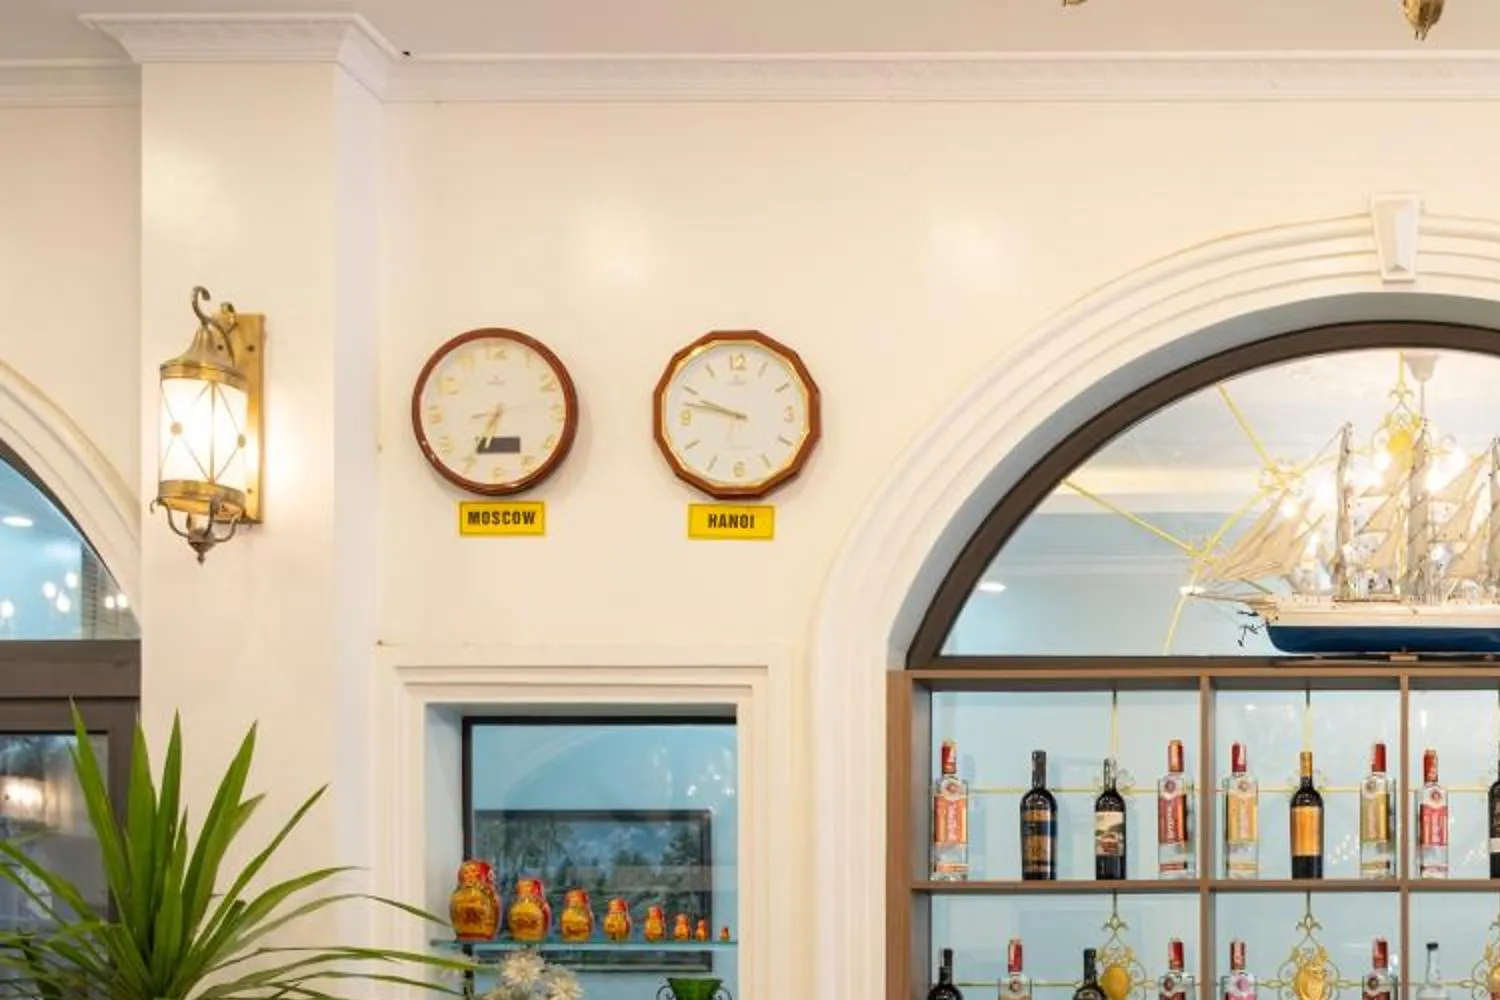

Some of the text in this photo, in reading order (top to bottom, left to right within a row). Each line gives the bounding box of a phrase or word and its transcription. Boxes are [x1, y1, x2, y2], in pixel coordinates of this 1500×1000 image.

[729, 353, 747, 371] 12
[680, 408, 693, 427] 9
[783, 405, 796, 424] 3
[733, 460, 746, 478] 6
[467, 511, 537, 526] MOSCOW
[708, 513, 755, 529] HANOI
